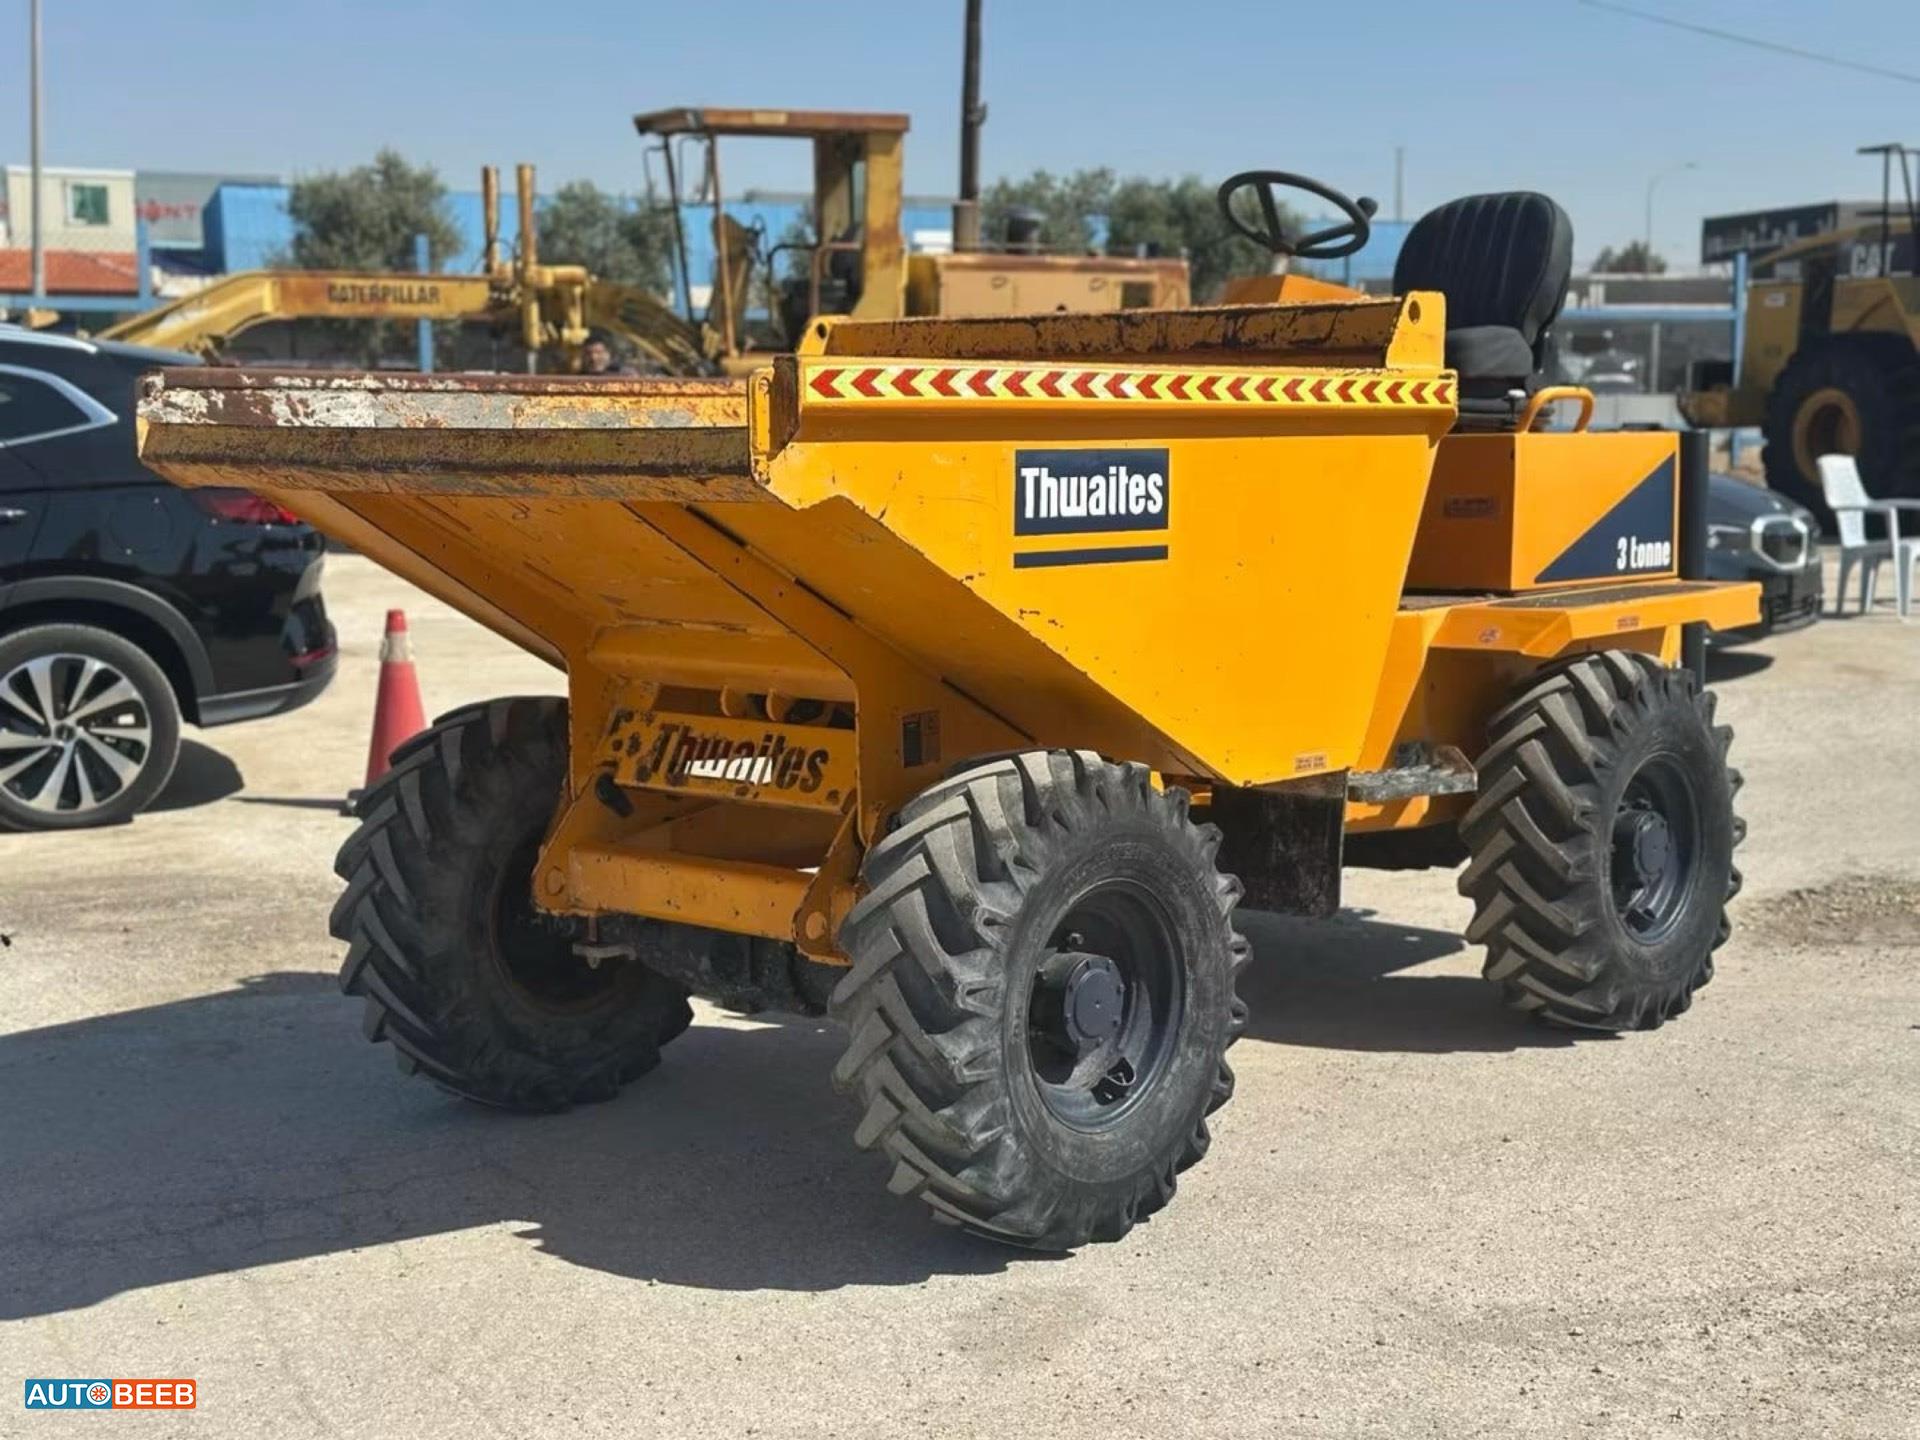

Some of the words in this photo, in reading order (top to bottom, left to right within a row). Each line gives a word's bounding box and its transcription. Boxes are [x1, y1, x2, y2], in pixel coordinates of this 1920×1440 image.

[327, 282, 440, 304] CATERPILLAR
[1020, 466, 1163, 519] Thwaites
[1616, 536, 1628, 570] 3
[1630, 535, 1671, 569] tonne
[652, 722, 829, 794] Thwaites
